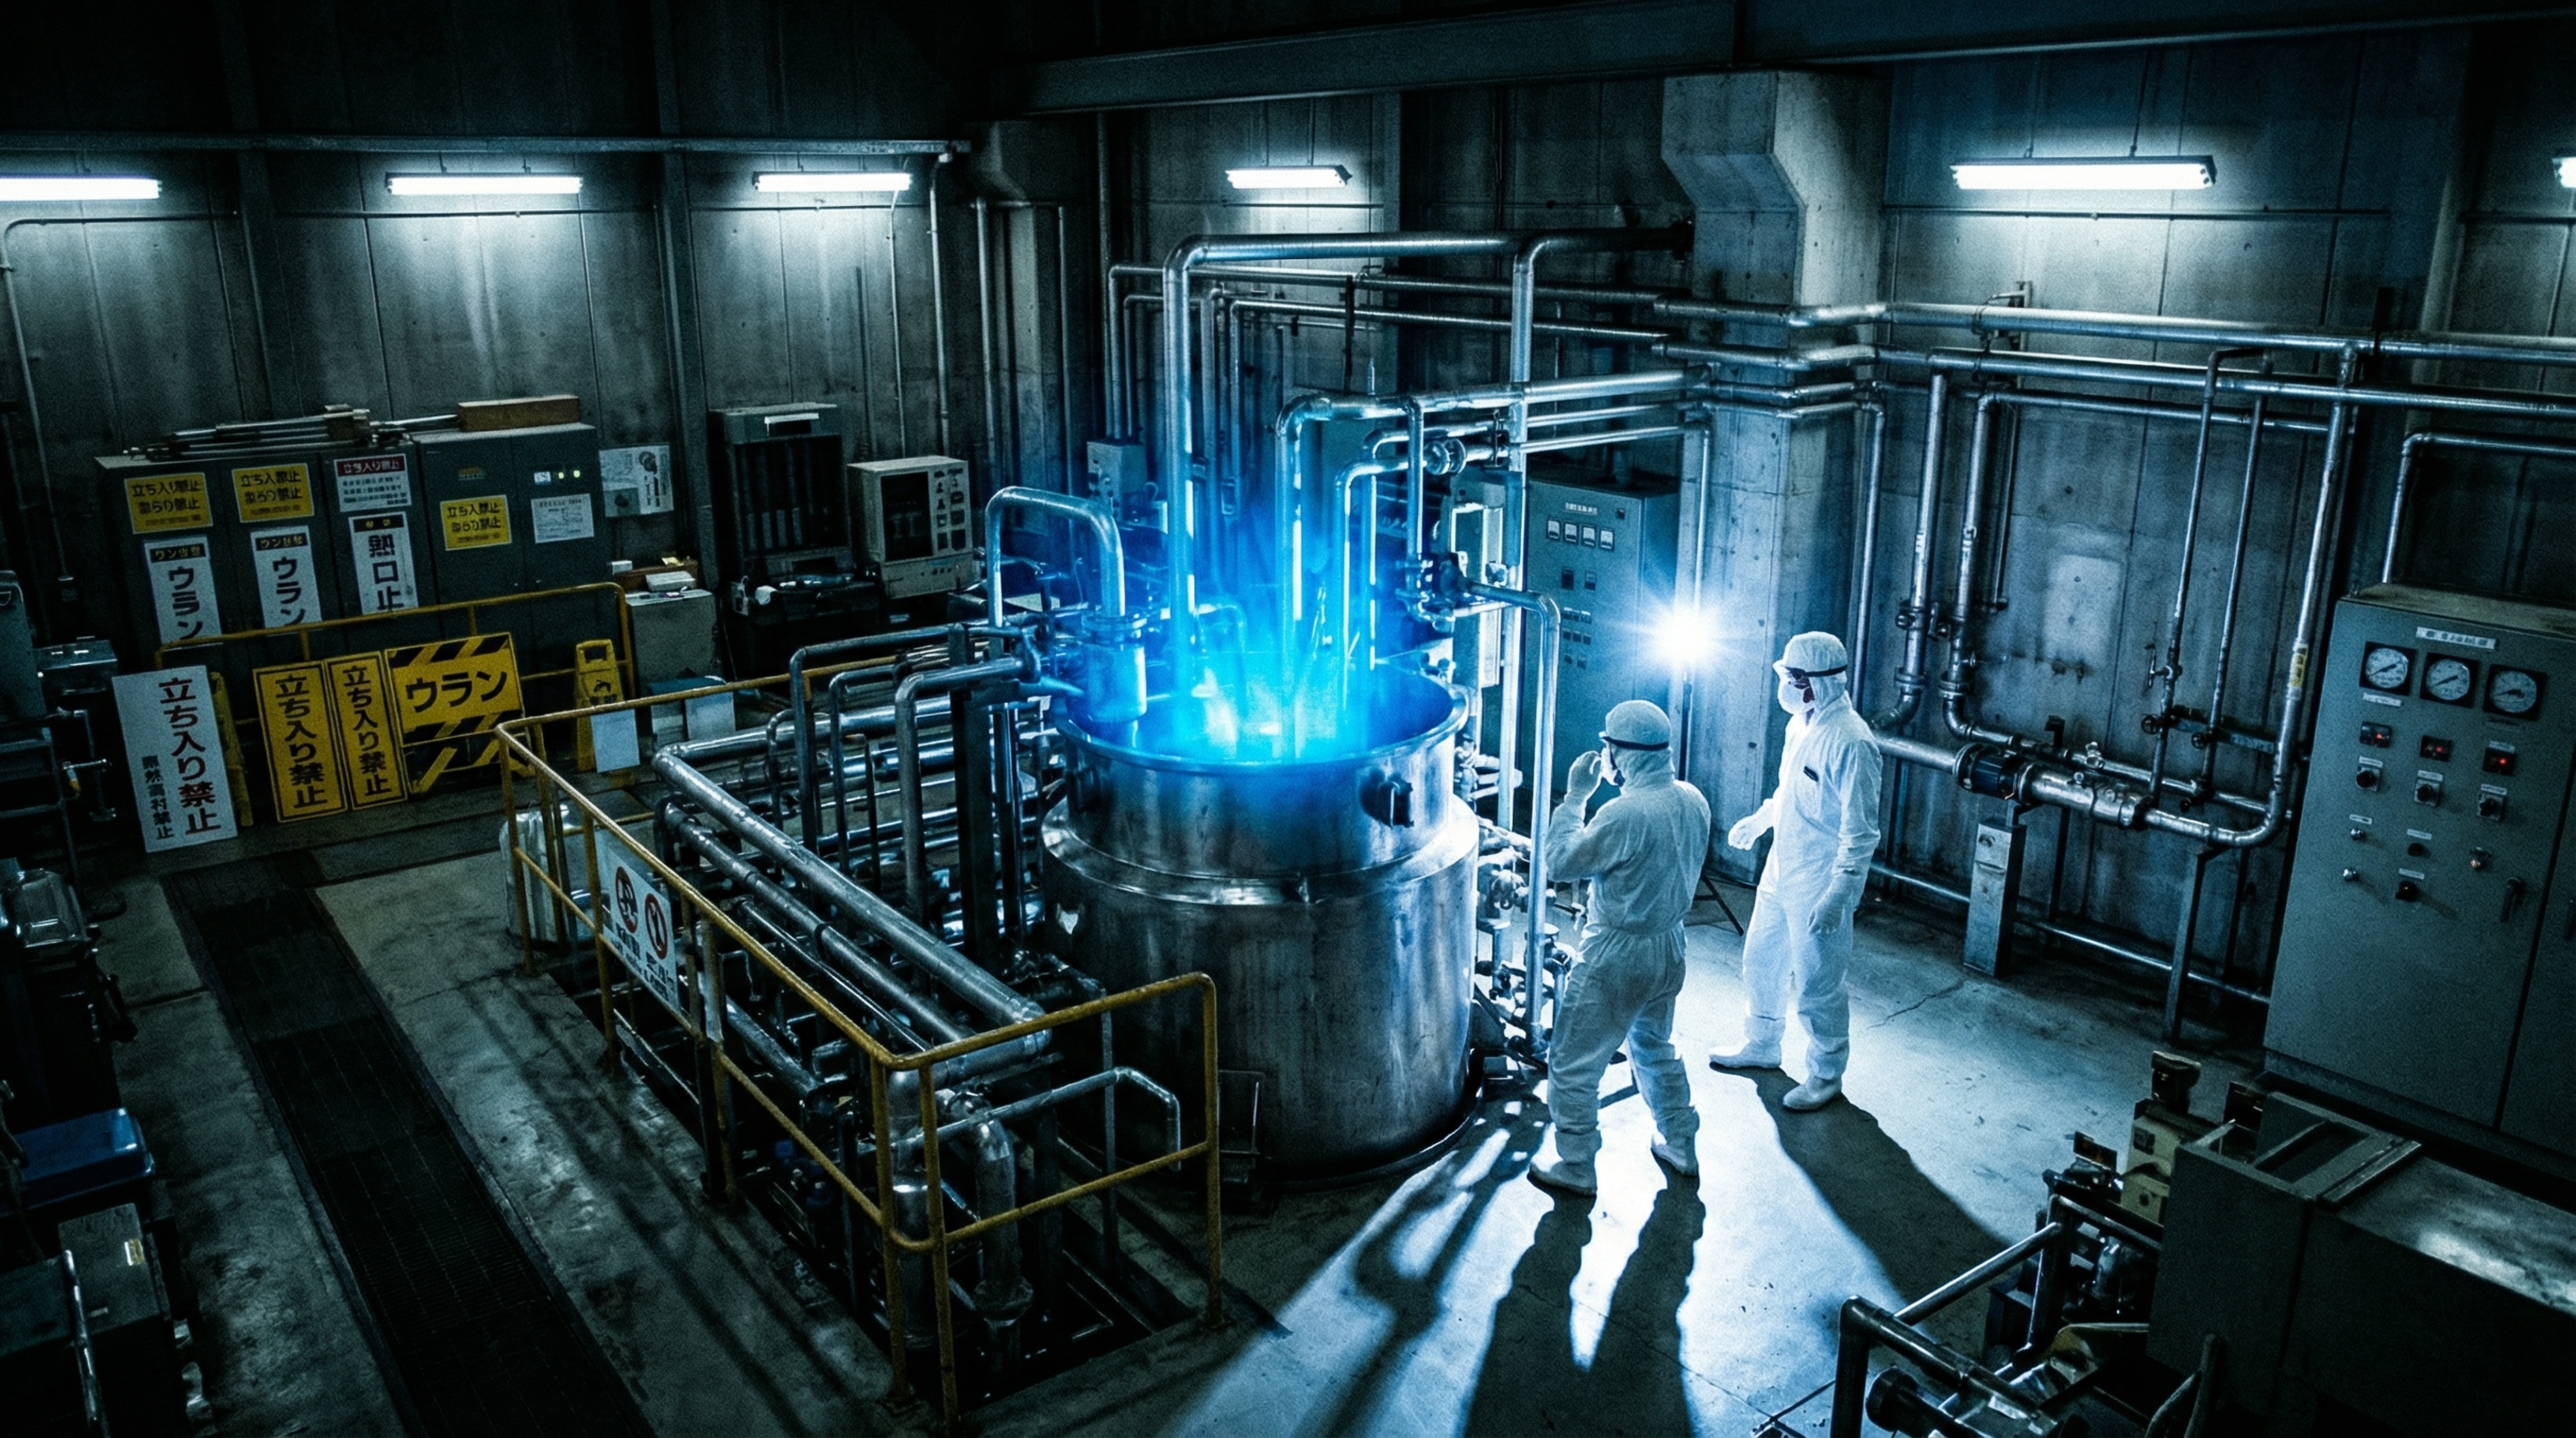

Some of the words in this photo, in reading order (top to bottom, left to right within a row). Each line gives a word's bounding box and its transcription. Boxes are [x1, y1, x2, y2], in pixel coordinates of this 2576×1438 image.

[272, 556, 306, 626] ウラン
[159, 677, 221, 835] 立ち入り禁止
[275, 675, 328, 809] 立ち入り禁止
[343, 665, 392, 796] 立ち入り禁止
[405, 670, 508, 711] ウラン
